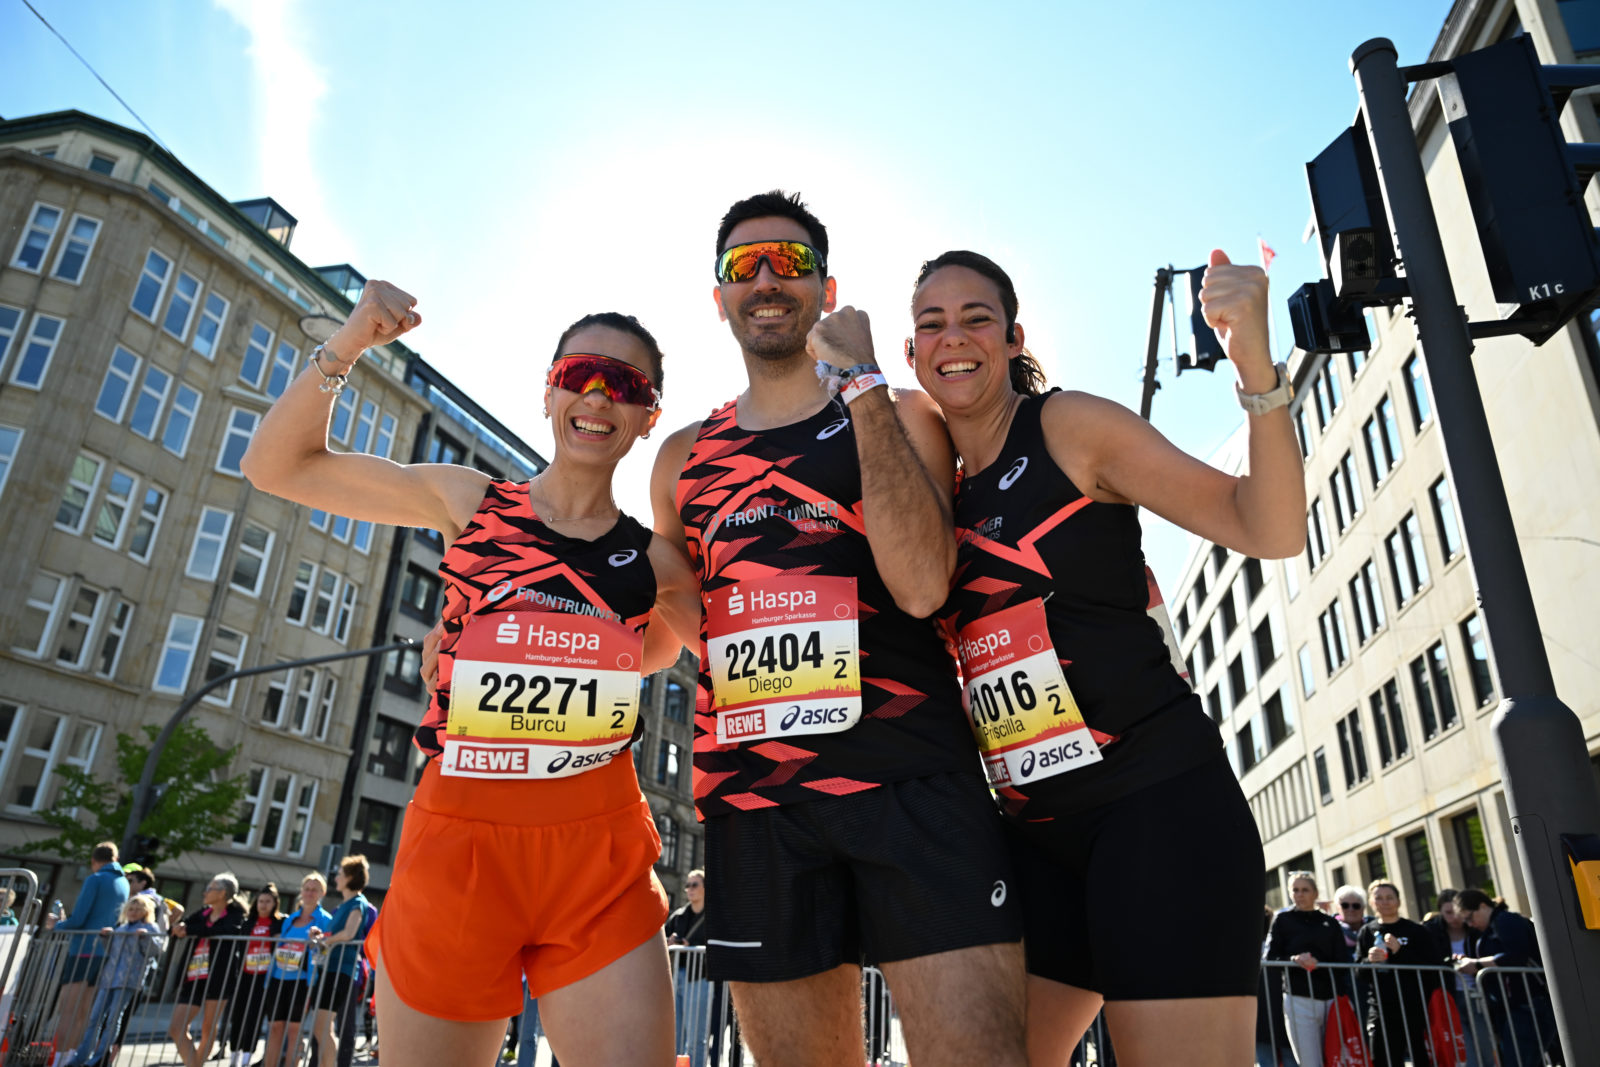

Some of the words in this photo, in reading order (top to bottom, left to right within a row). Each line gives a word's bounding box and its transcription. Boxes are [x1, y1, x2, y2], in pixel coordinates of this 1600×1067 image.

[797, 518, 840, 532] ERMANY
[750, 589, 817, 612] Haspa
[751, 615, 784, 625] Hamburger
[784, 612, 817, 621] Sparkasse
[526, 623, 601, 655] Haspa
[964, 628, 1012, 662] Haspa
[525, 652, 563, 665] Hamburger
[563, 655, 599, 666] Sparkasse
[725, 630, 824, 682] 22404
[833, 658, 848, 680] 2
[477, 671, 598, 717] 22271
[748, 675, 793, 694] Diego
[1047, 692, 1066, 716] 2
[510, 714, 566, 733] Burcu
[610, 709, 626, 730] 2
[726, 712, 764, 736] REWE
[983, 718, 1026, 743] Priscilla
[458, 749, 526, 771] REWE
